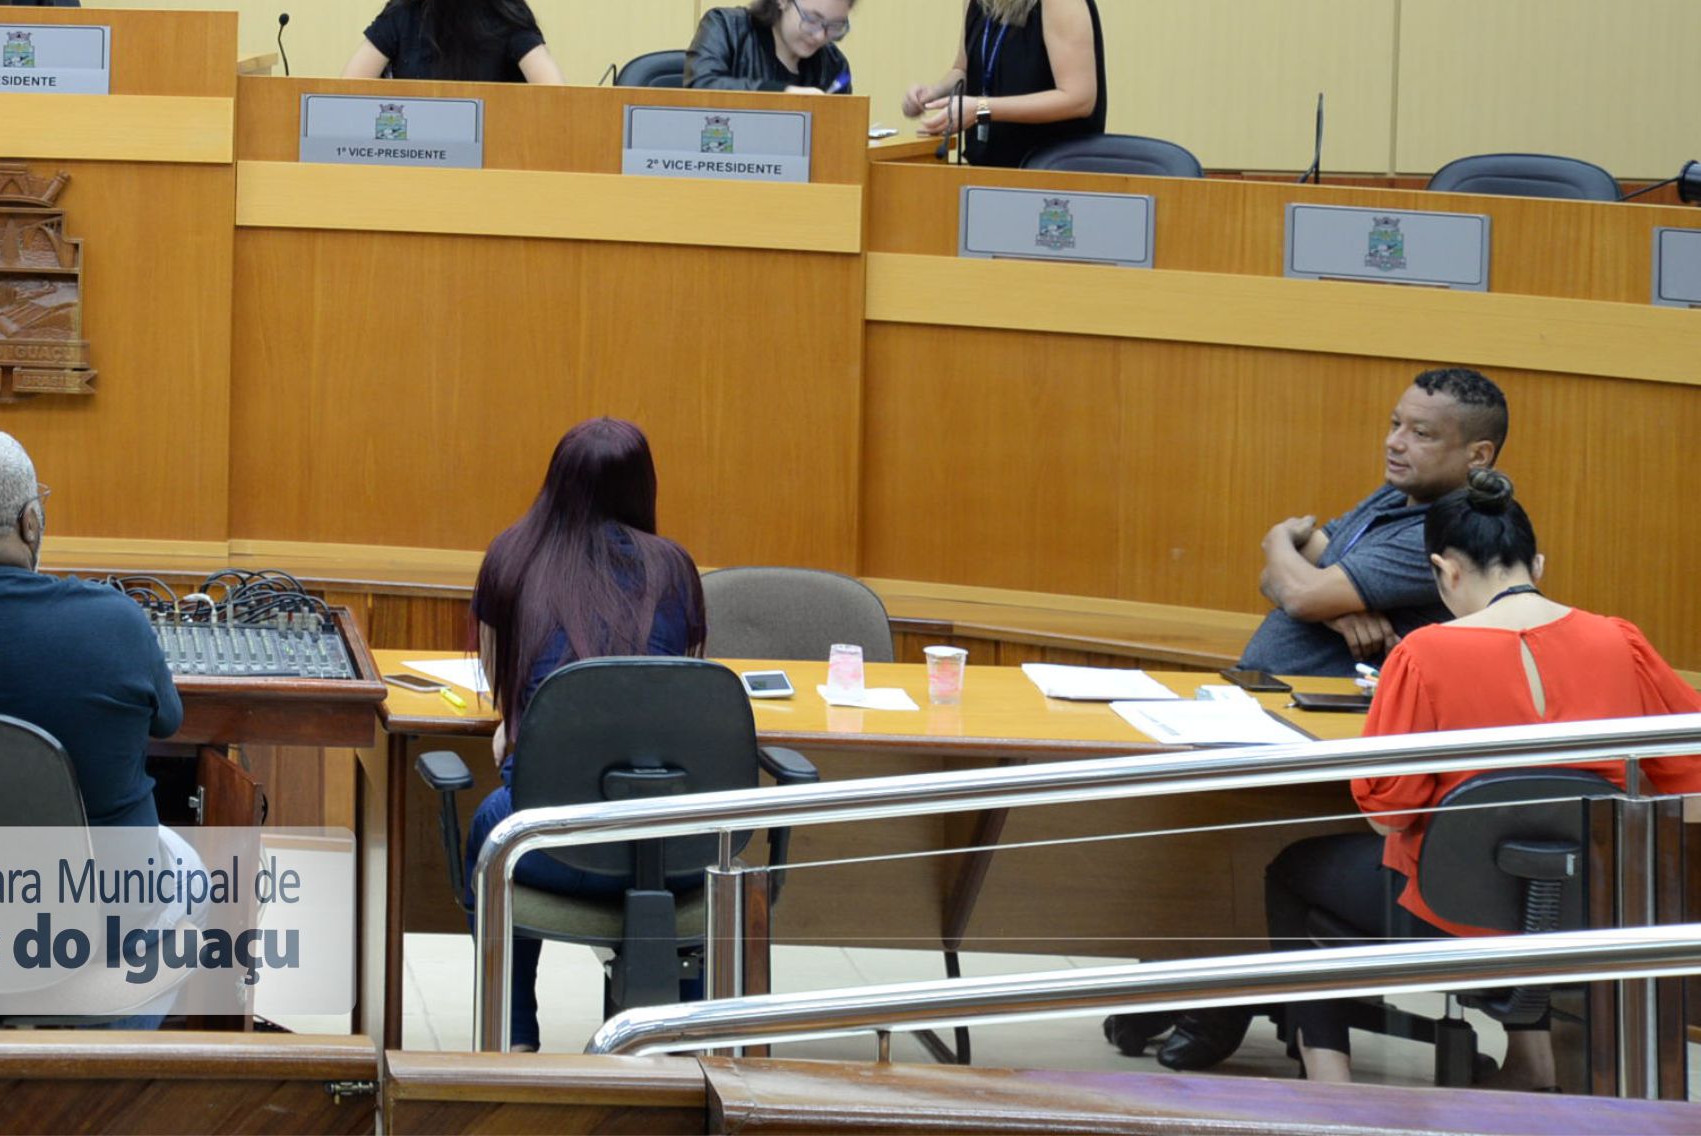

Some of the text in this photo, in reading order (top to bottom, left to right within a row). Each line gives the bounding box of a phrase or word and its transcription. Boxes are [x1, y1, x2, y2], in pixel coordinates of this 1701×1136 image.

[336, 147, 447, 160] 1º VICE-PRESIDENTE
[646, 158, 783, 175] 2º VICE-PRESIDENTE
